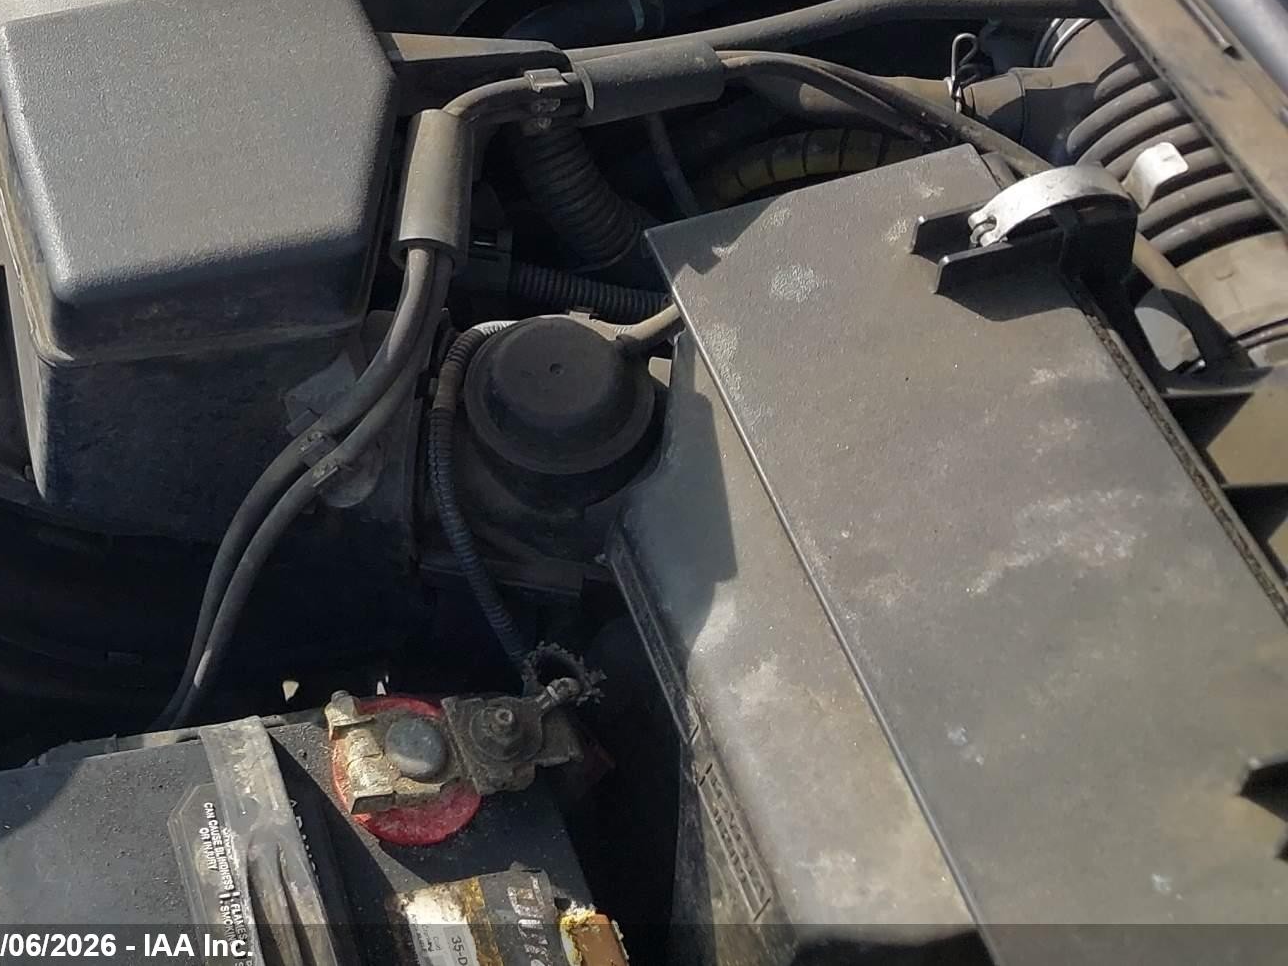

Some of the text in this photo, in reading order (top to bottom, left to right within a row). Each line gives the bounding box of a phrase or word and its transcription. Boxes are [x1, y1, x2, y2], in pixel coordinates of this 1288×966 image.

[204, 802, 215, 819] CAN
[199, 827, 219, 871] OR INJURY
[209, 819, 223, 846] CAUSE
[214, 846, 235, 891] BLINDNESS
[220, 905, 235, 946] SMOKIN
